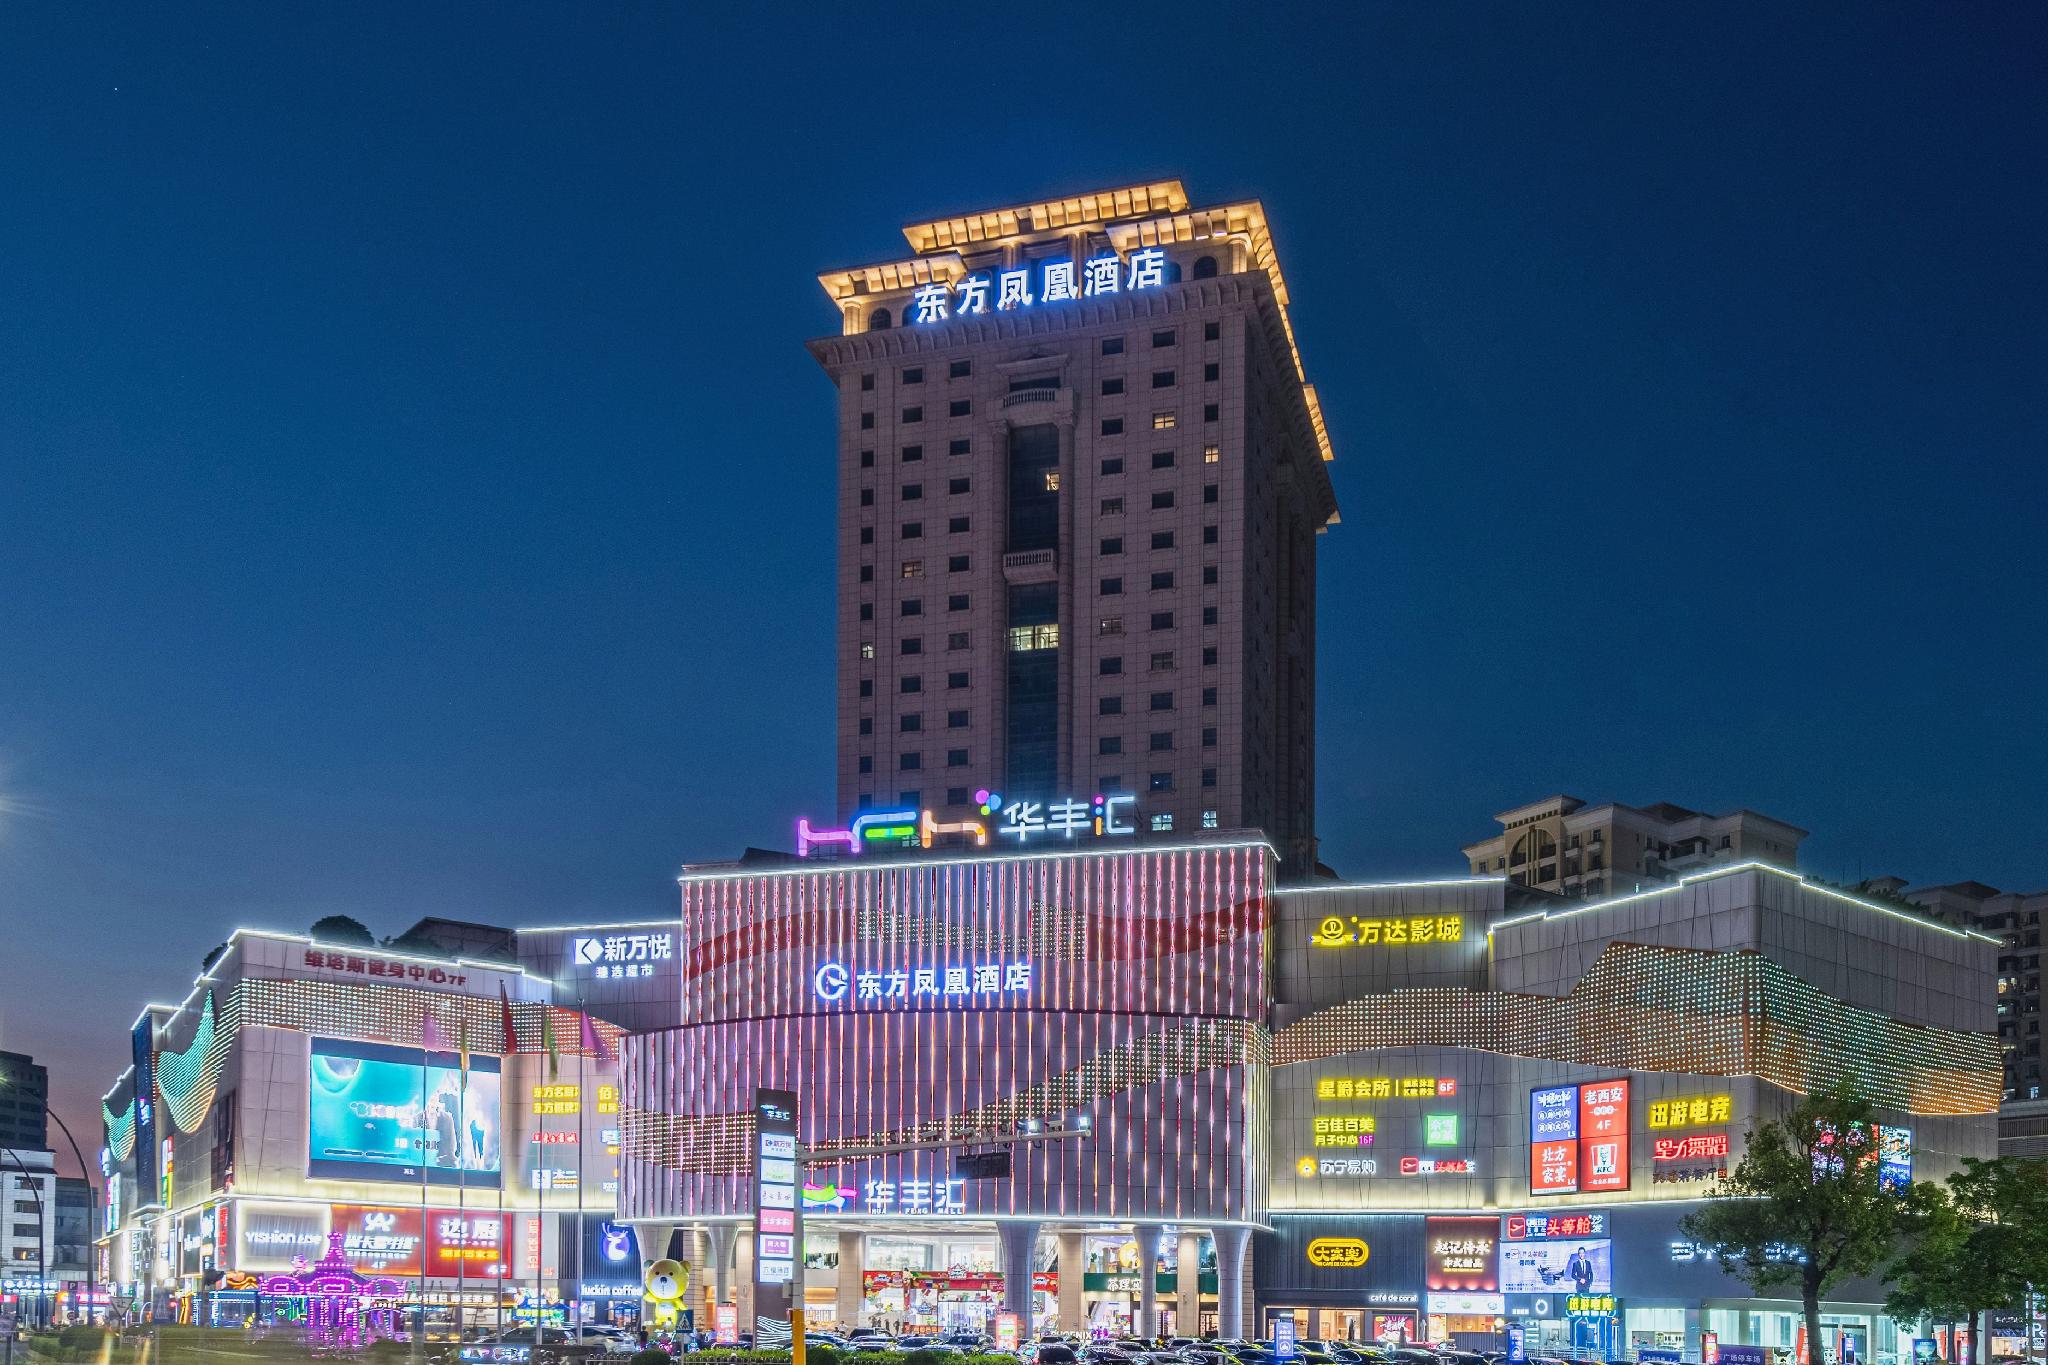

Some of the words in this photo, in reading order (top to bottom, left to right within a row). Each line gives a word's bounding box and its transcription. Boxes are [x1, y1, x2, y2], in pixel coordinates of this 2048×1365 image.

[915, 249, 1165, 323] 东方凤凰酒店
[1000, 796, 1135, 841] 华丰汇
[1358, 917, 1461, 943] 万达影城
[605, 934, 672, 961] 新万悦
[304, 949, 447, 983] 维塔斯健身中心
[448, 975, 467, 985] 7F
[857, 962, 1032, 998] 东方凤凰酒店
[1319, 1079, 1390, 1097] 星爵会所
[1439, 1082, 1454, 1092] 6F
[1585, 1087, 1623, 1104] 老西安
[1650, 1096, 1730, 1128] 迅游电竞
[1315, 1118, 1374, 1132] 百佳百美
[1596, 1120, 1611, 1131] 4F
[1315, 1135, 1358, 1146] 月子中心
[1359, 1135, 1373, 1145] 16F
[1319, 1159, 1376, 1174] 苏宁易购
[865, 1179, 966, 1208] 华丰汇
[1547, 1217, 1591, 1236] 头等舱
[245, 1230, 296, 1243] YISHION
[371, 1261, 386, 1269] 4F
[581, 1284, 610, 1295] luckin
